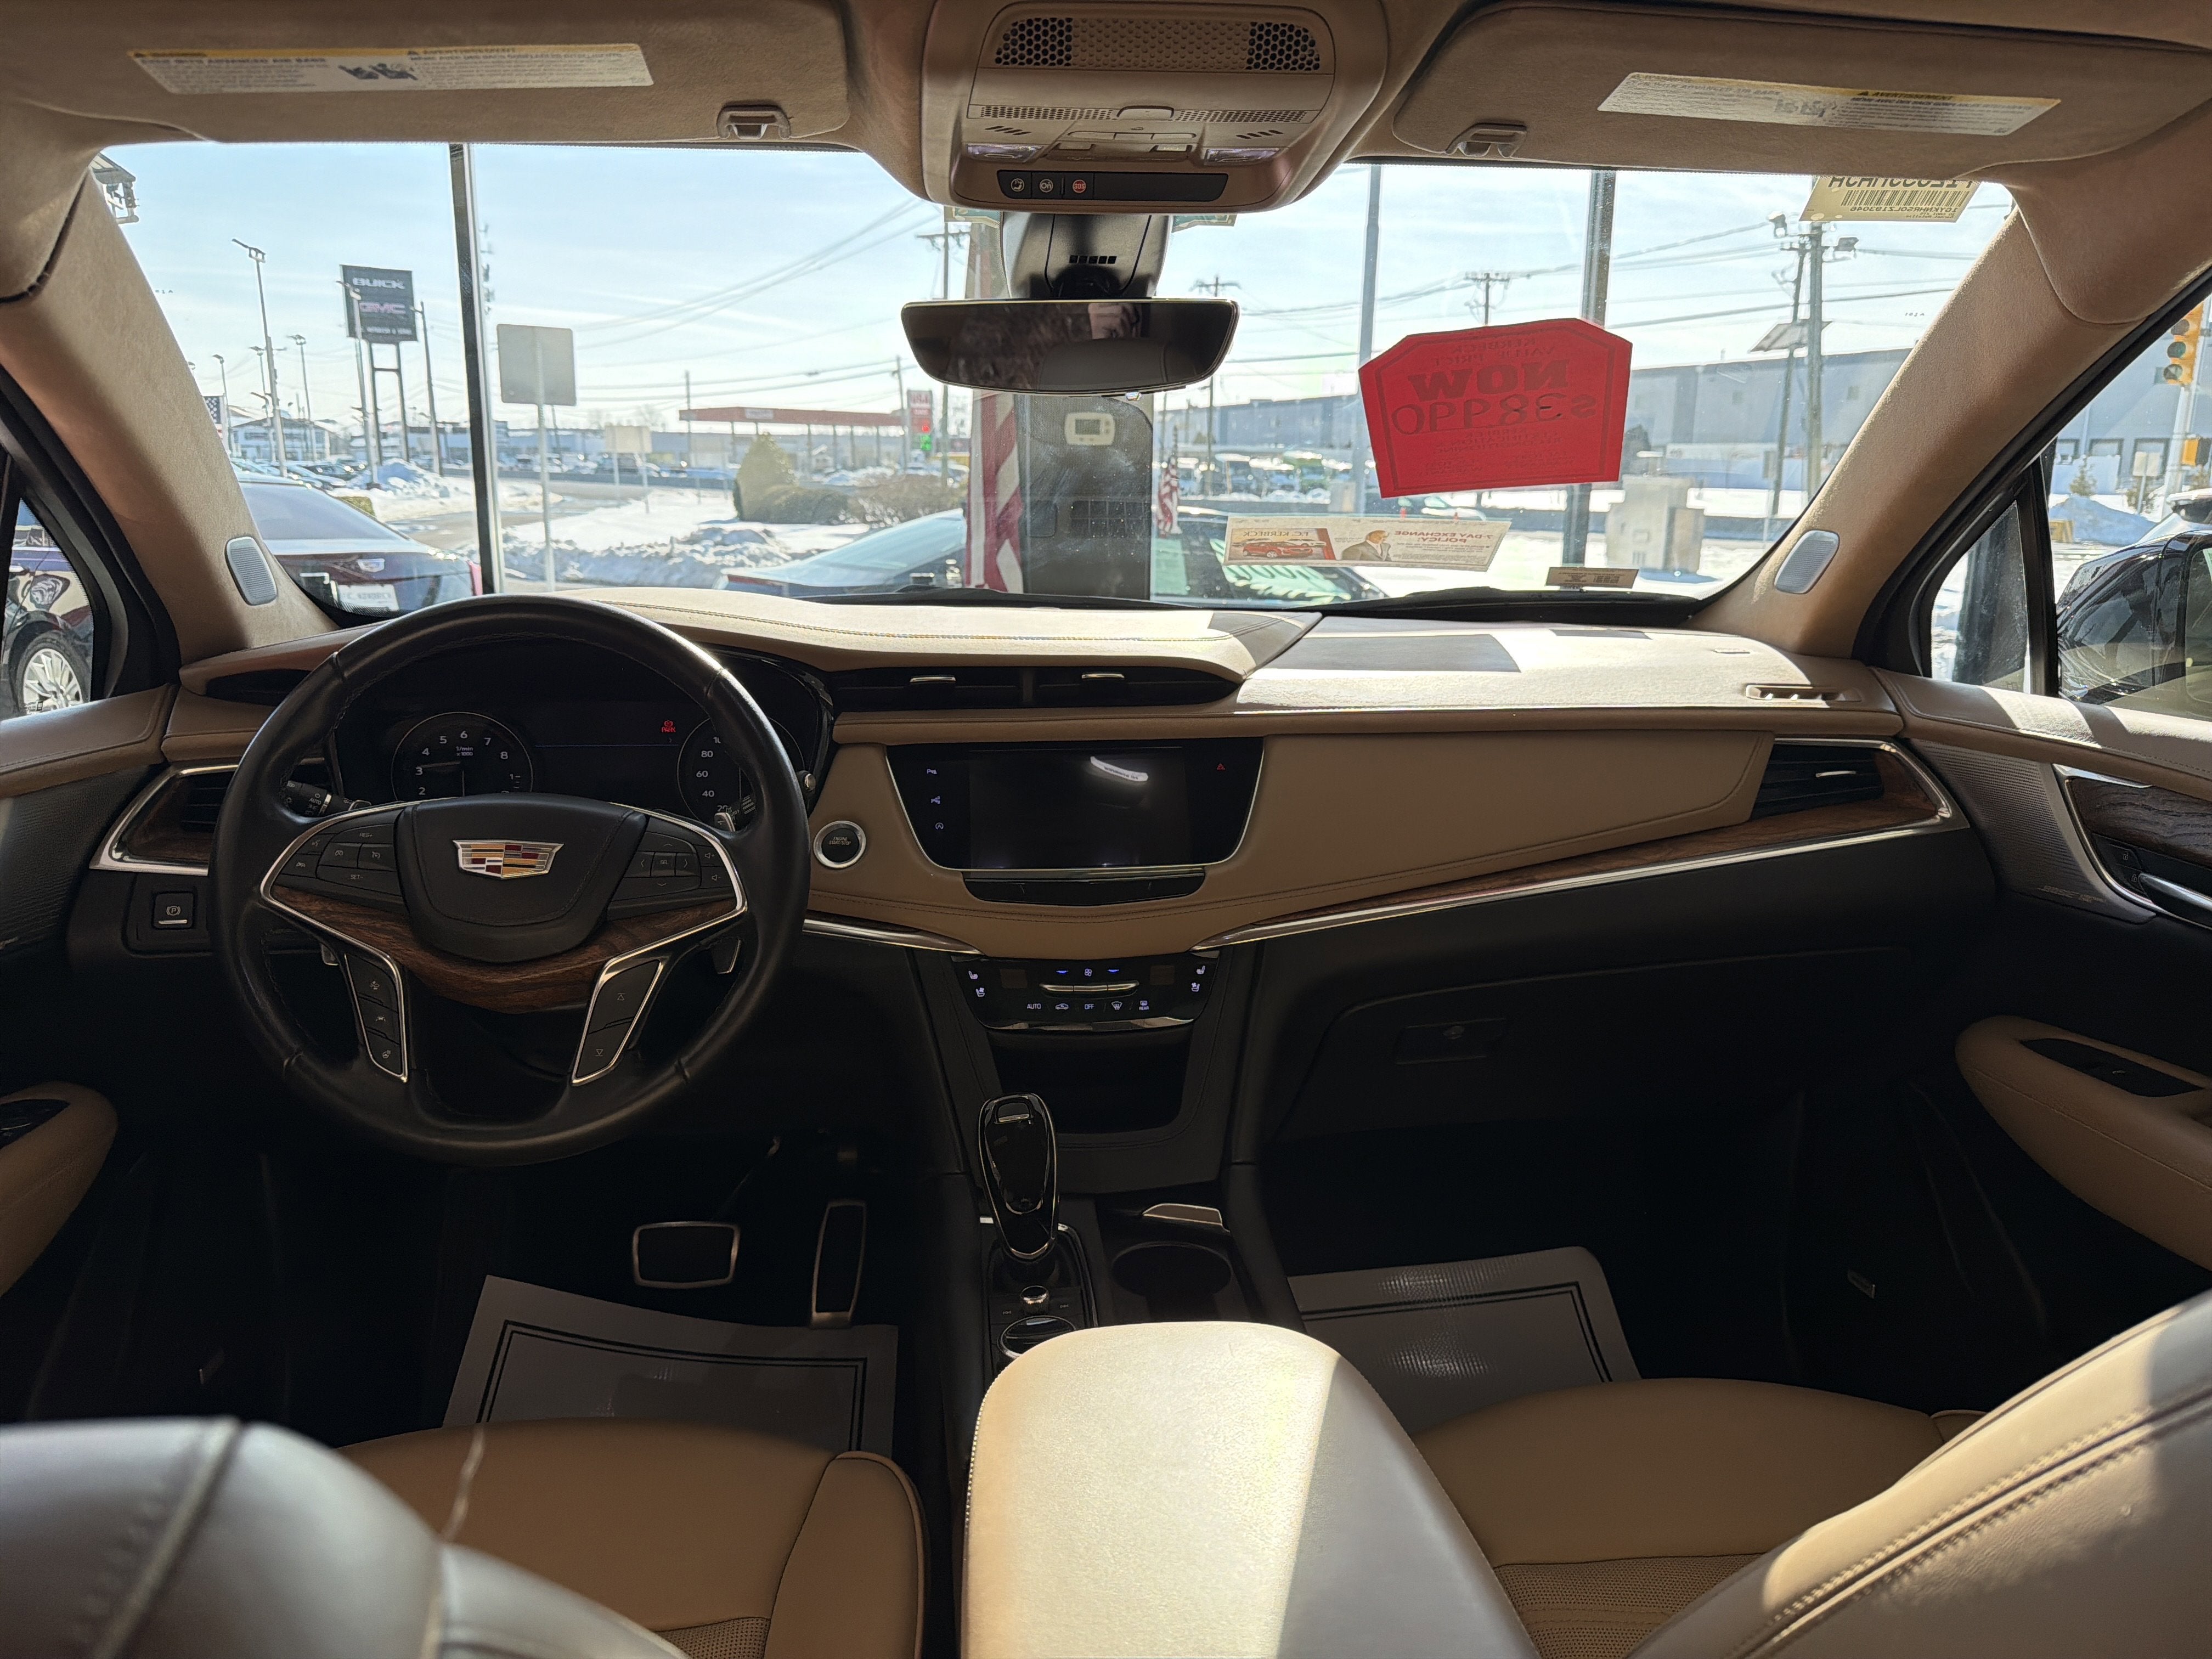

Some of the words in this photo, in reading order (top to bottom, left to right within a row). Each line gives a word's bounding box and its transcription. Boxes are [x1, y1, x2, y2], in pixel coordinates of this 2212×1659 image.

[352, 276, 405, 290] BUICK
[359, 301, 406, 314] GMC
[460, 730, 468, 739] 6
[439, 736, 447, 744] 5
[483, 737, 492, 746] 7
[421, 747, 430, 756] 4
[500, 751, 509, 760] 8
[415, 767, 423, 776] 3
[418, 787, 426, 795] 2
